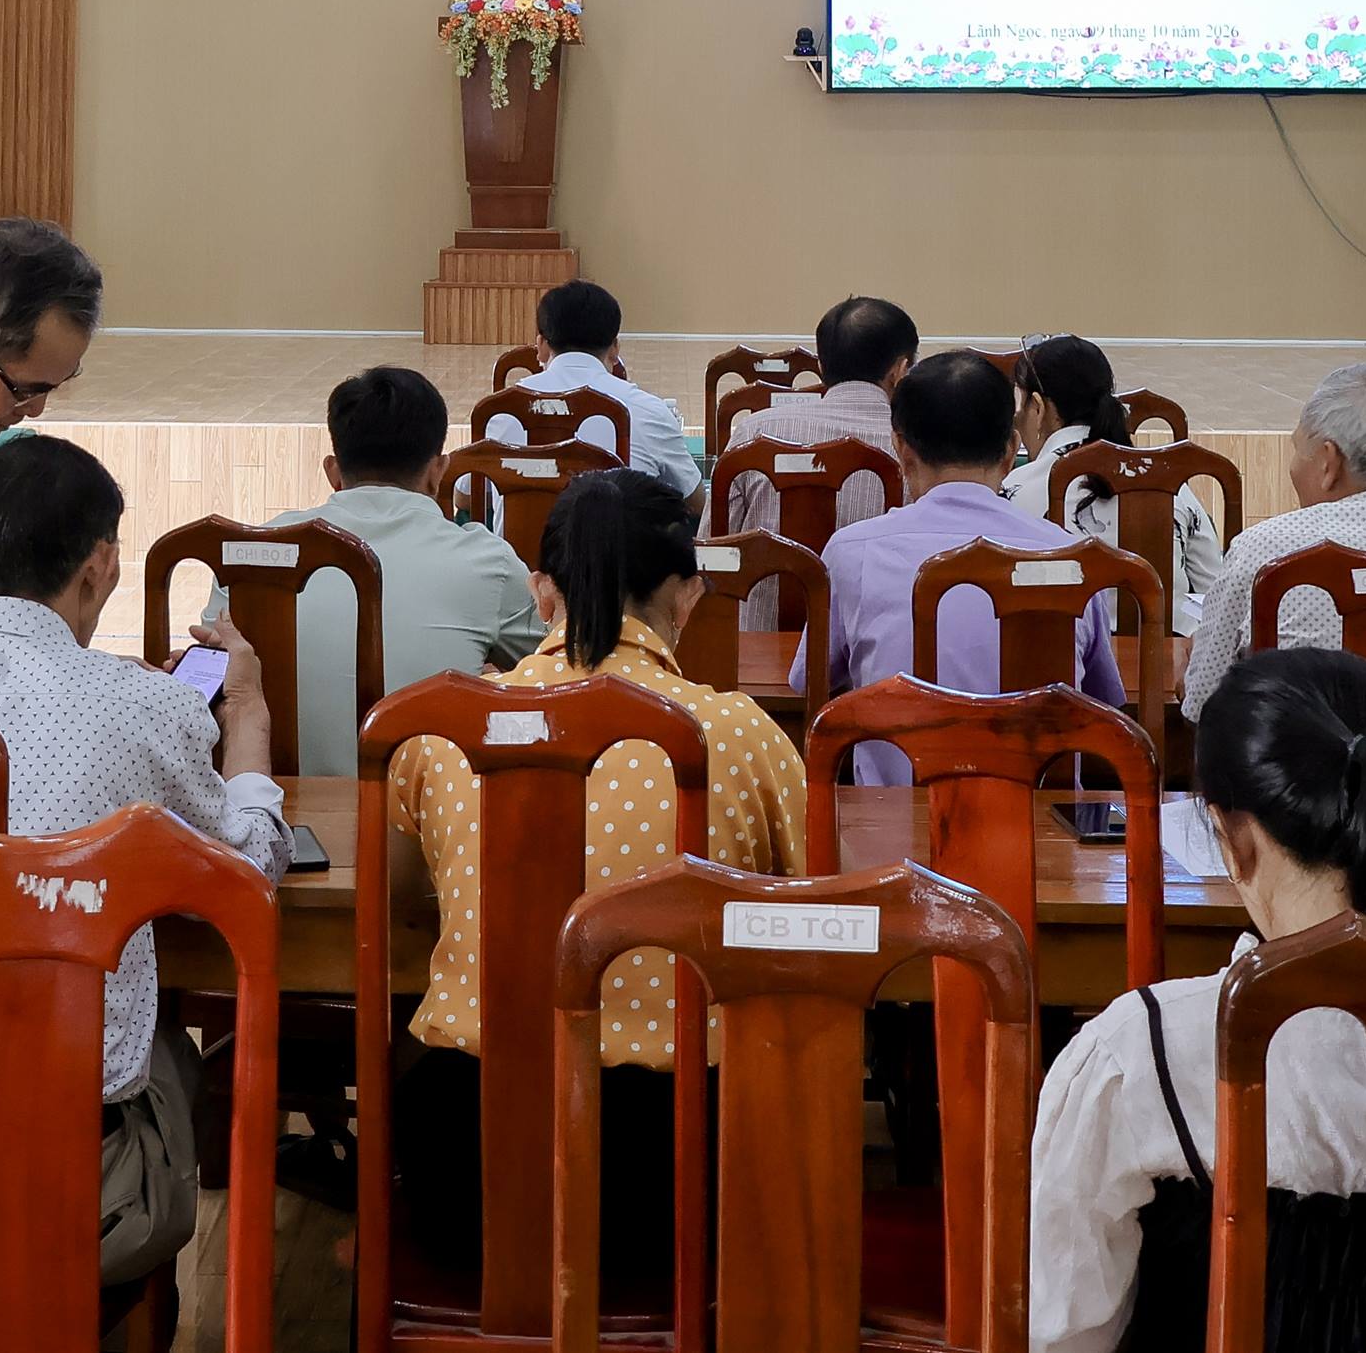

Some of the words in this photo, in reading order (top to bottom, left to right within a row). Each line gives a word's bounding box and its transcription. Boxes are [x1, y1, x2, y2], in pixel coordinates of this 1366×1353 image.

[1205, 24, 1240, 40] 2026
[746, 914, 791, 938] CB
[801, 917, 865, 941] TQT
